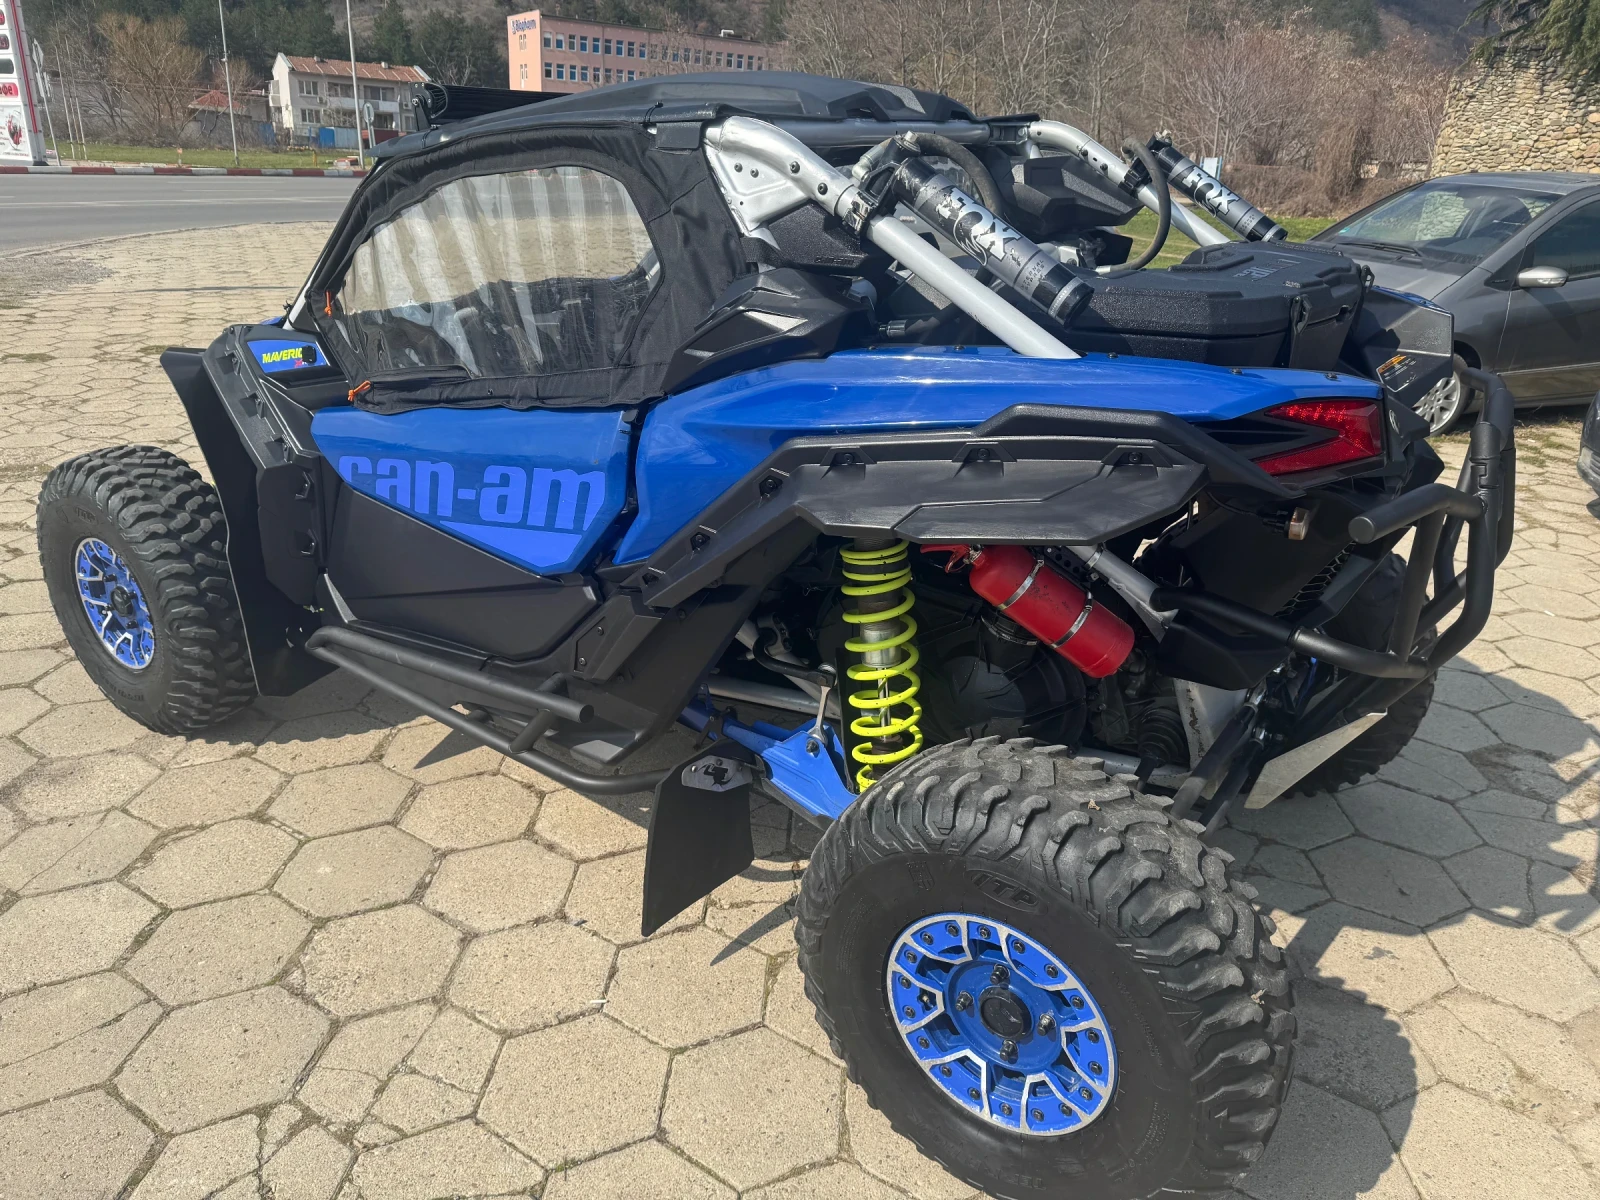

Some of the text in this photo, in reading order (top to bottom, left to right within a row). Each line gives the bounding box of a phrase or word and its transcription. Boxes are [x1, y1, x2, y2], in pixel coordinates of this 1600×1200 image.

[1182, 166, 1241, 216] FOX
[936, 186, 1023, 264] FOX
[262, 347, 303, 363] MAVERIC
[338, 456, 605, 531] can-am
[970, 873, 1039, 907] ITP
